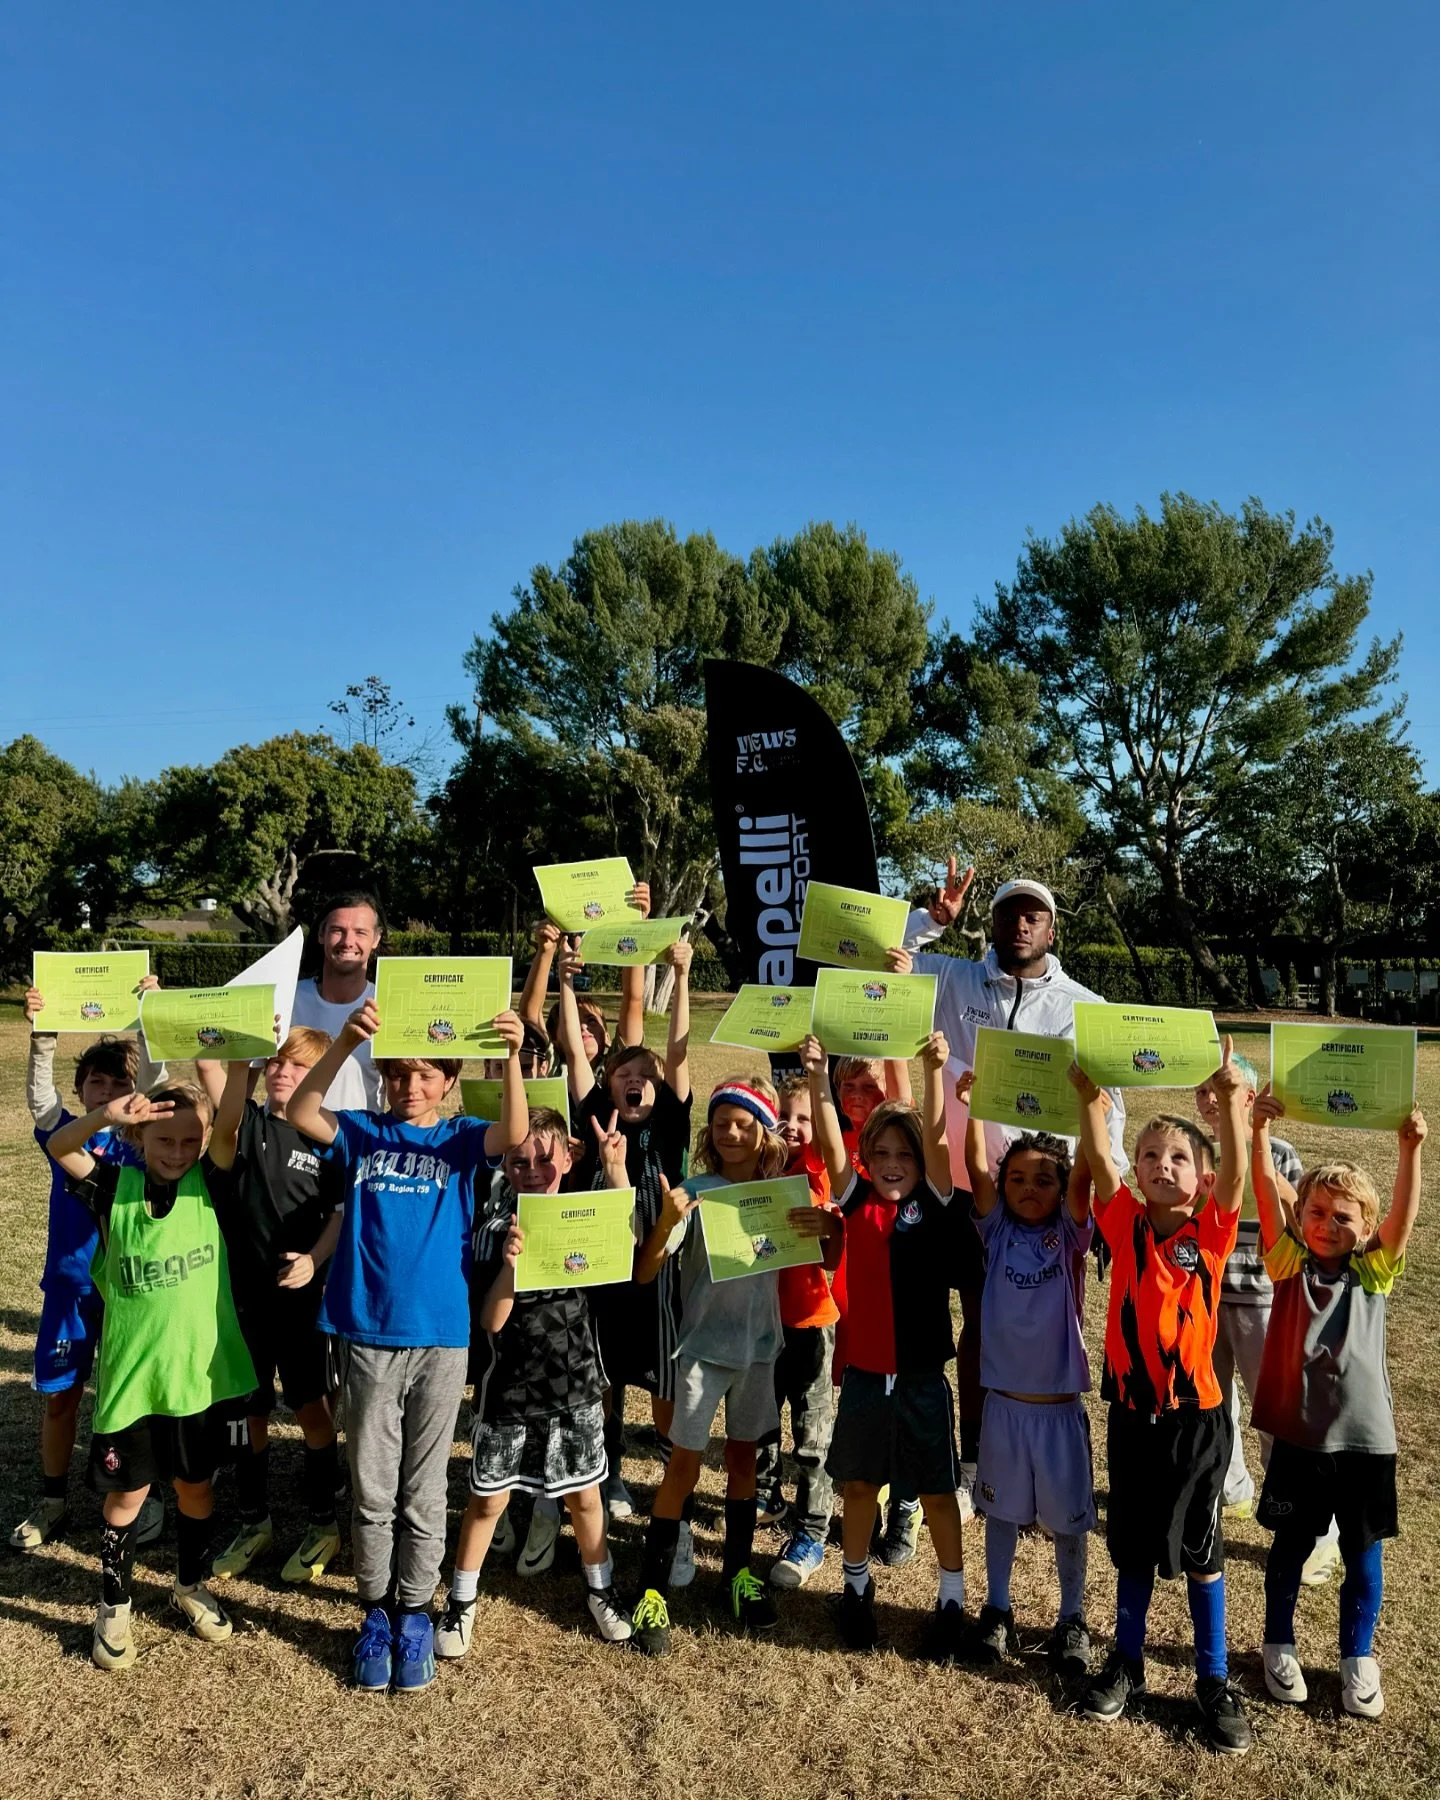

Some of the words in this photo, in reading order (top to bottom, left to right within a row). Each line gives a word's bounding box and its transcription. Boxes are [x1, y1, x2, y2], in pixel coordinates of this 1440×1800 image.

[737, 753, 769, 774] F.C.
[738, 814, 800, 986] apelli
[840, 902, 871, 915] CERTIFICATE
[75, 966, 109, 974] CERTIFICATE
[424, 974, 464, 983] CERTIFICATE
[1122, 1015, 1165, 1024] CERTIFICATE
[749, 1027, 780, 1038] CERTIFICATE
[852, 1031, 889, 1041] CERTIFICATE
[1321, 1042, 1364, 1054] CERTIFICATE
[1014, 1048, 1052, 1062] CERTIFICATE
[388, 1183, 415, 1193] Region
[739, 1195, 772, 1208] CERTIFICATE
[561, 1208, 596, 1219] CERTIFICATE
[1005, 1263, 1063, 1286] Rakuten
[227, 1419, 248, 1446] 11
